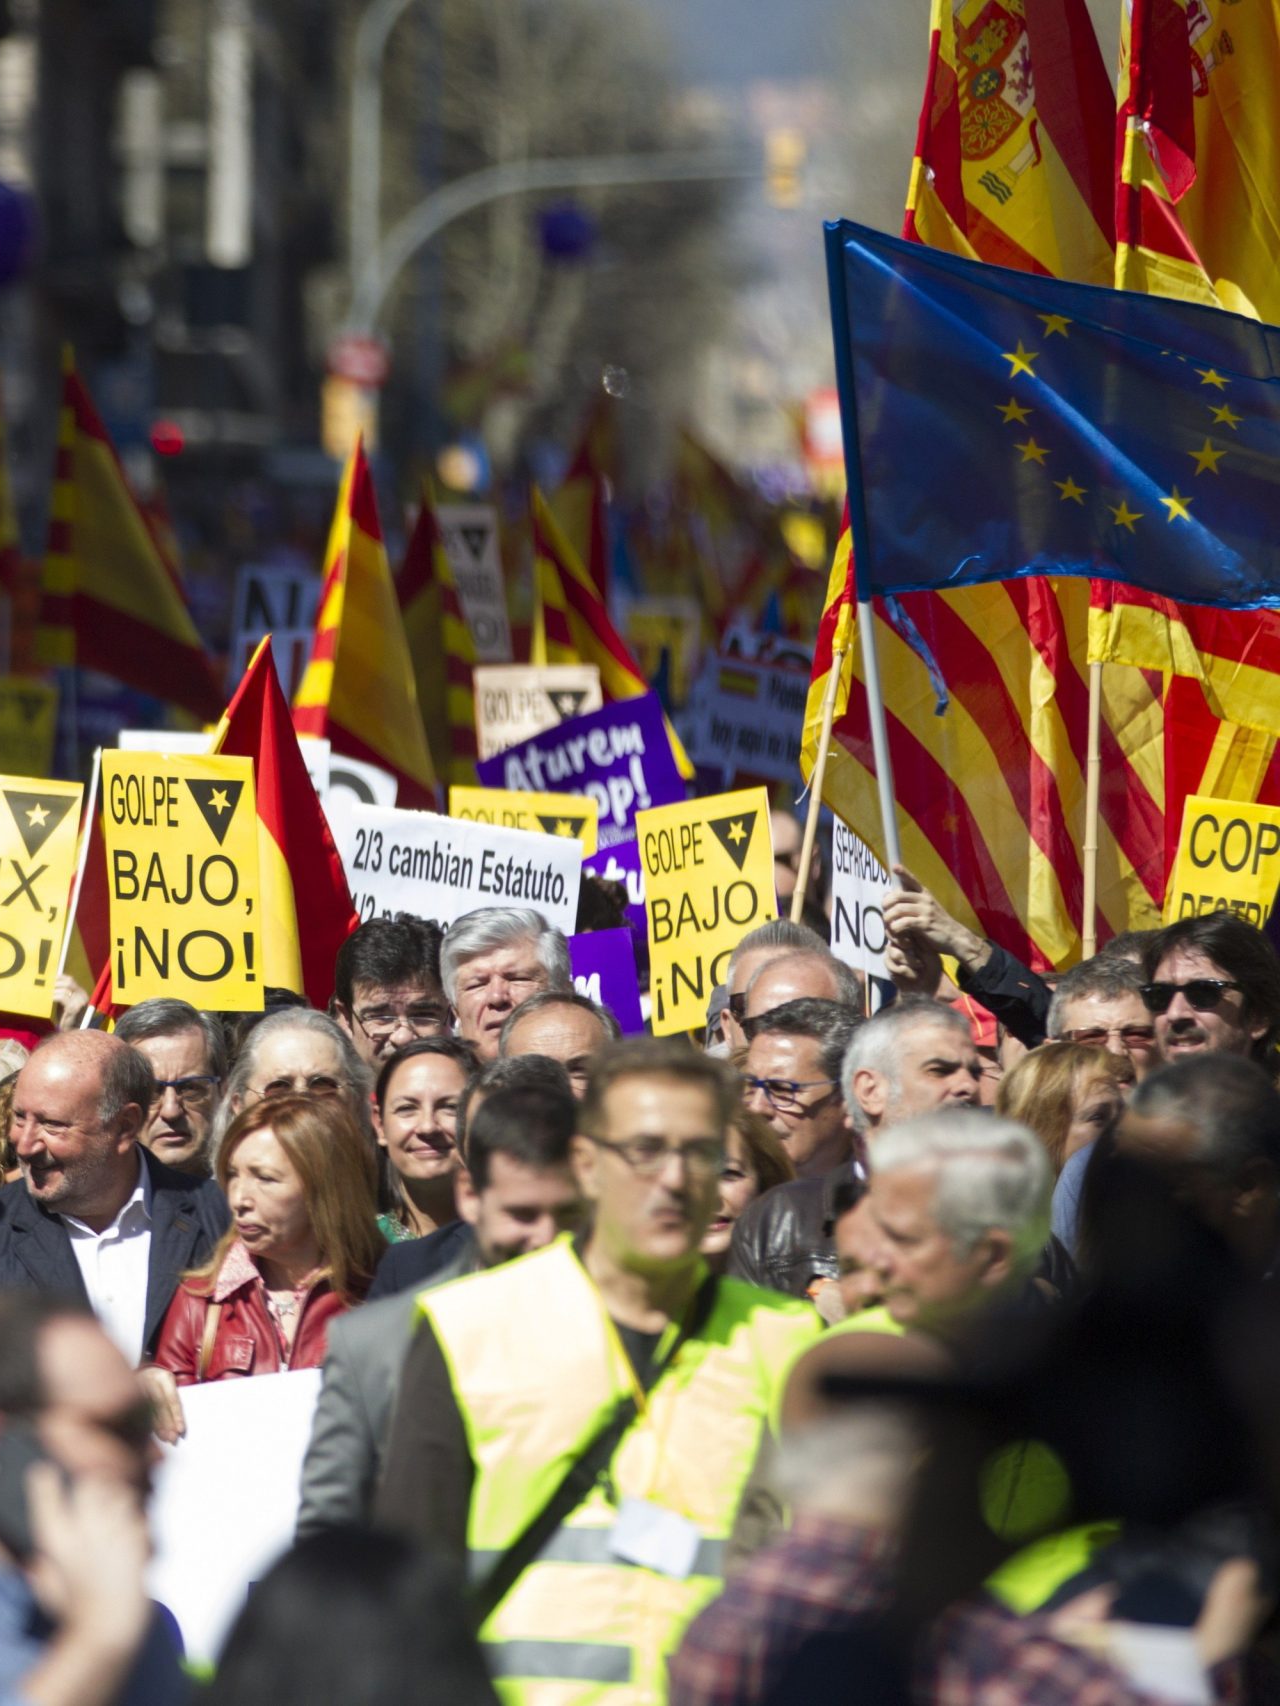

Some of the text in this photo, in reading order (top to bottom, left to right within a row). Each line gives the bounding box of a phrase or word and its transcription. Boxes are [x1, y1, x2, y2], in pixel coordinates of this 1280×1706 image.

[503, 722, 647, 792] Aturem
[109, 773, 180, 828] GOLPE
[568, 754, 653, 828] op!
[353, 828, 384, 872] 2/3
[388, 840, 474, 890] cambian
[478, 849, 569, 906] Estatuto.
[644, 821, 705, 876] GOLPE
[835, 824, 892, 885] SEPARAD
[1188, 813, 1280, 876] COP
[112, 848, 254, 916] BAJO,
[117, 926, 257, 990] ¡NO!
